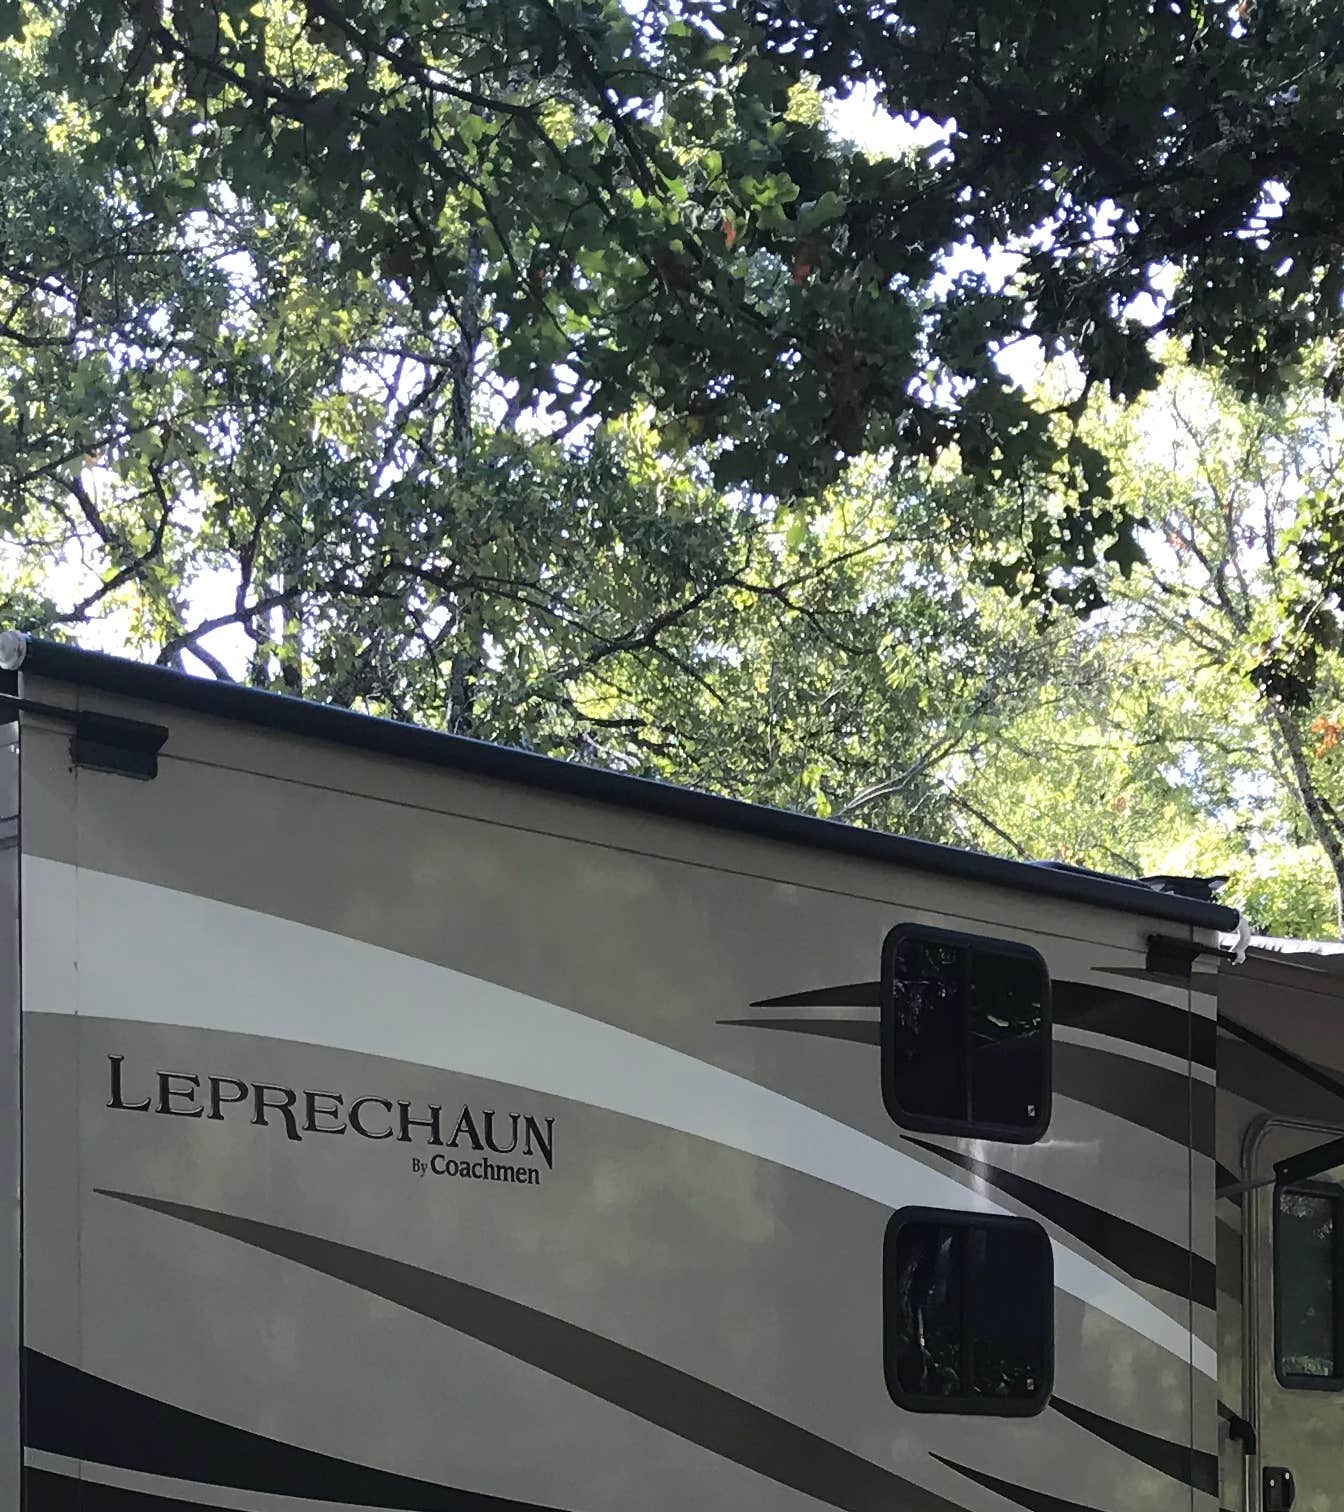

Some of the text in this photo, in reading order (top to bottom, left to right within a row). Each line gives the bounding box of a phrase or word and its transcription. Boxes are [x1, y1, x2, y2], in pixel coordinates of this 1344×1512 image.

[106, 1053, 555, 1170] LEPRECHAUN
[412, 1154, 540, 1185] By Coachmen
